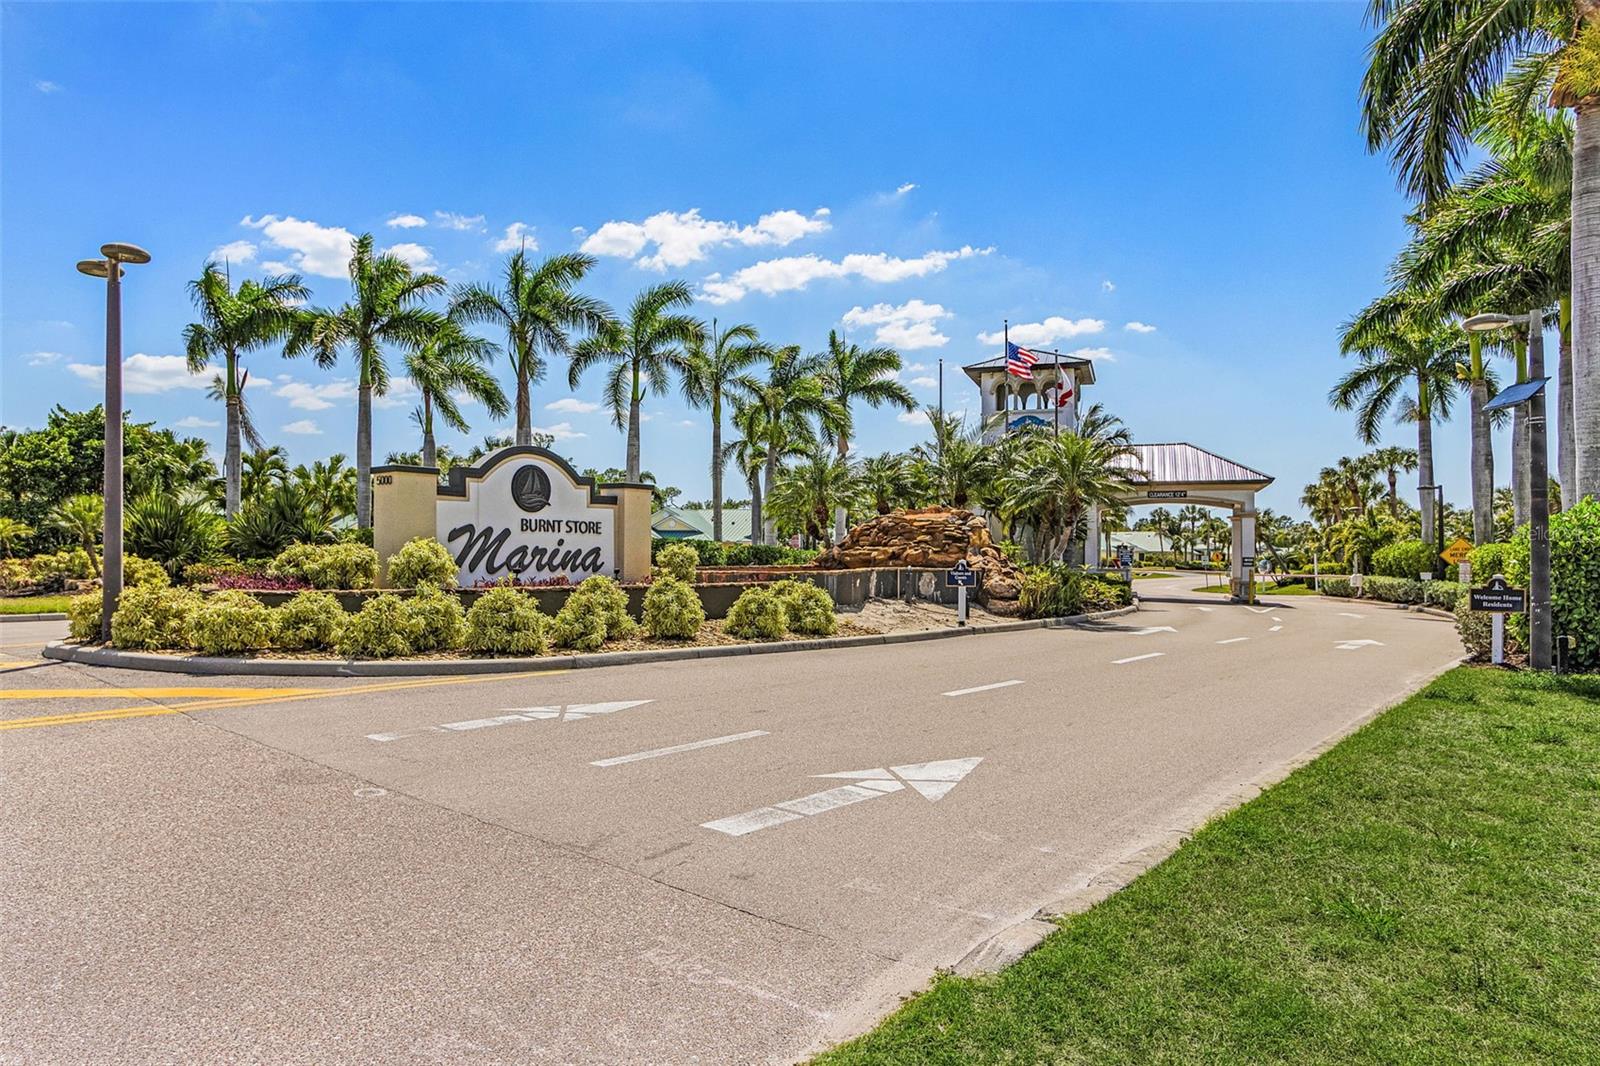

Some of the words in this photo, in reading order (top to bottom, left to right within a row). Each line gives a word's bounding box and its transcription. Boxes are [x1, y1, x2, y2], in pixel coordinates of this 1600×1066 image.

[376, 475, 392, 485] 5000
[520, 518, 563, 534] BURNT
[565, 520, 602, 535] STORE
[447, 523, 605, 575] Marina
